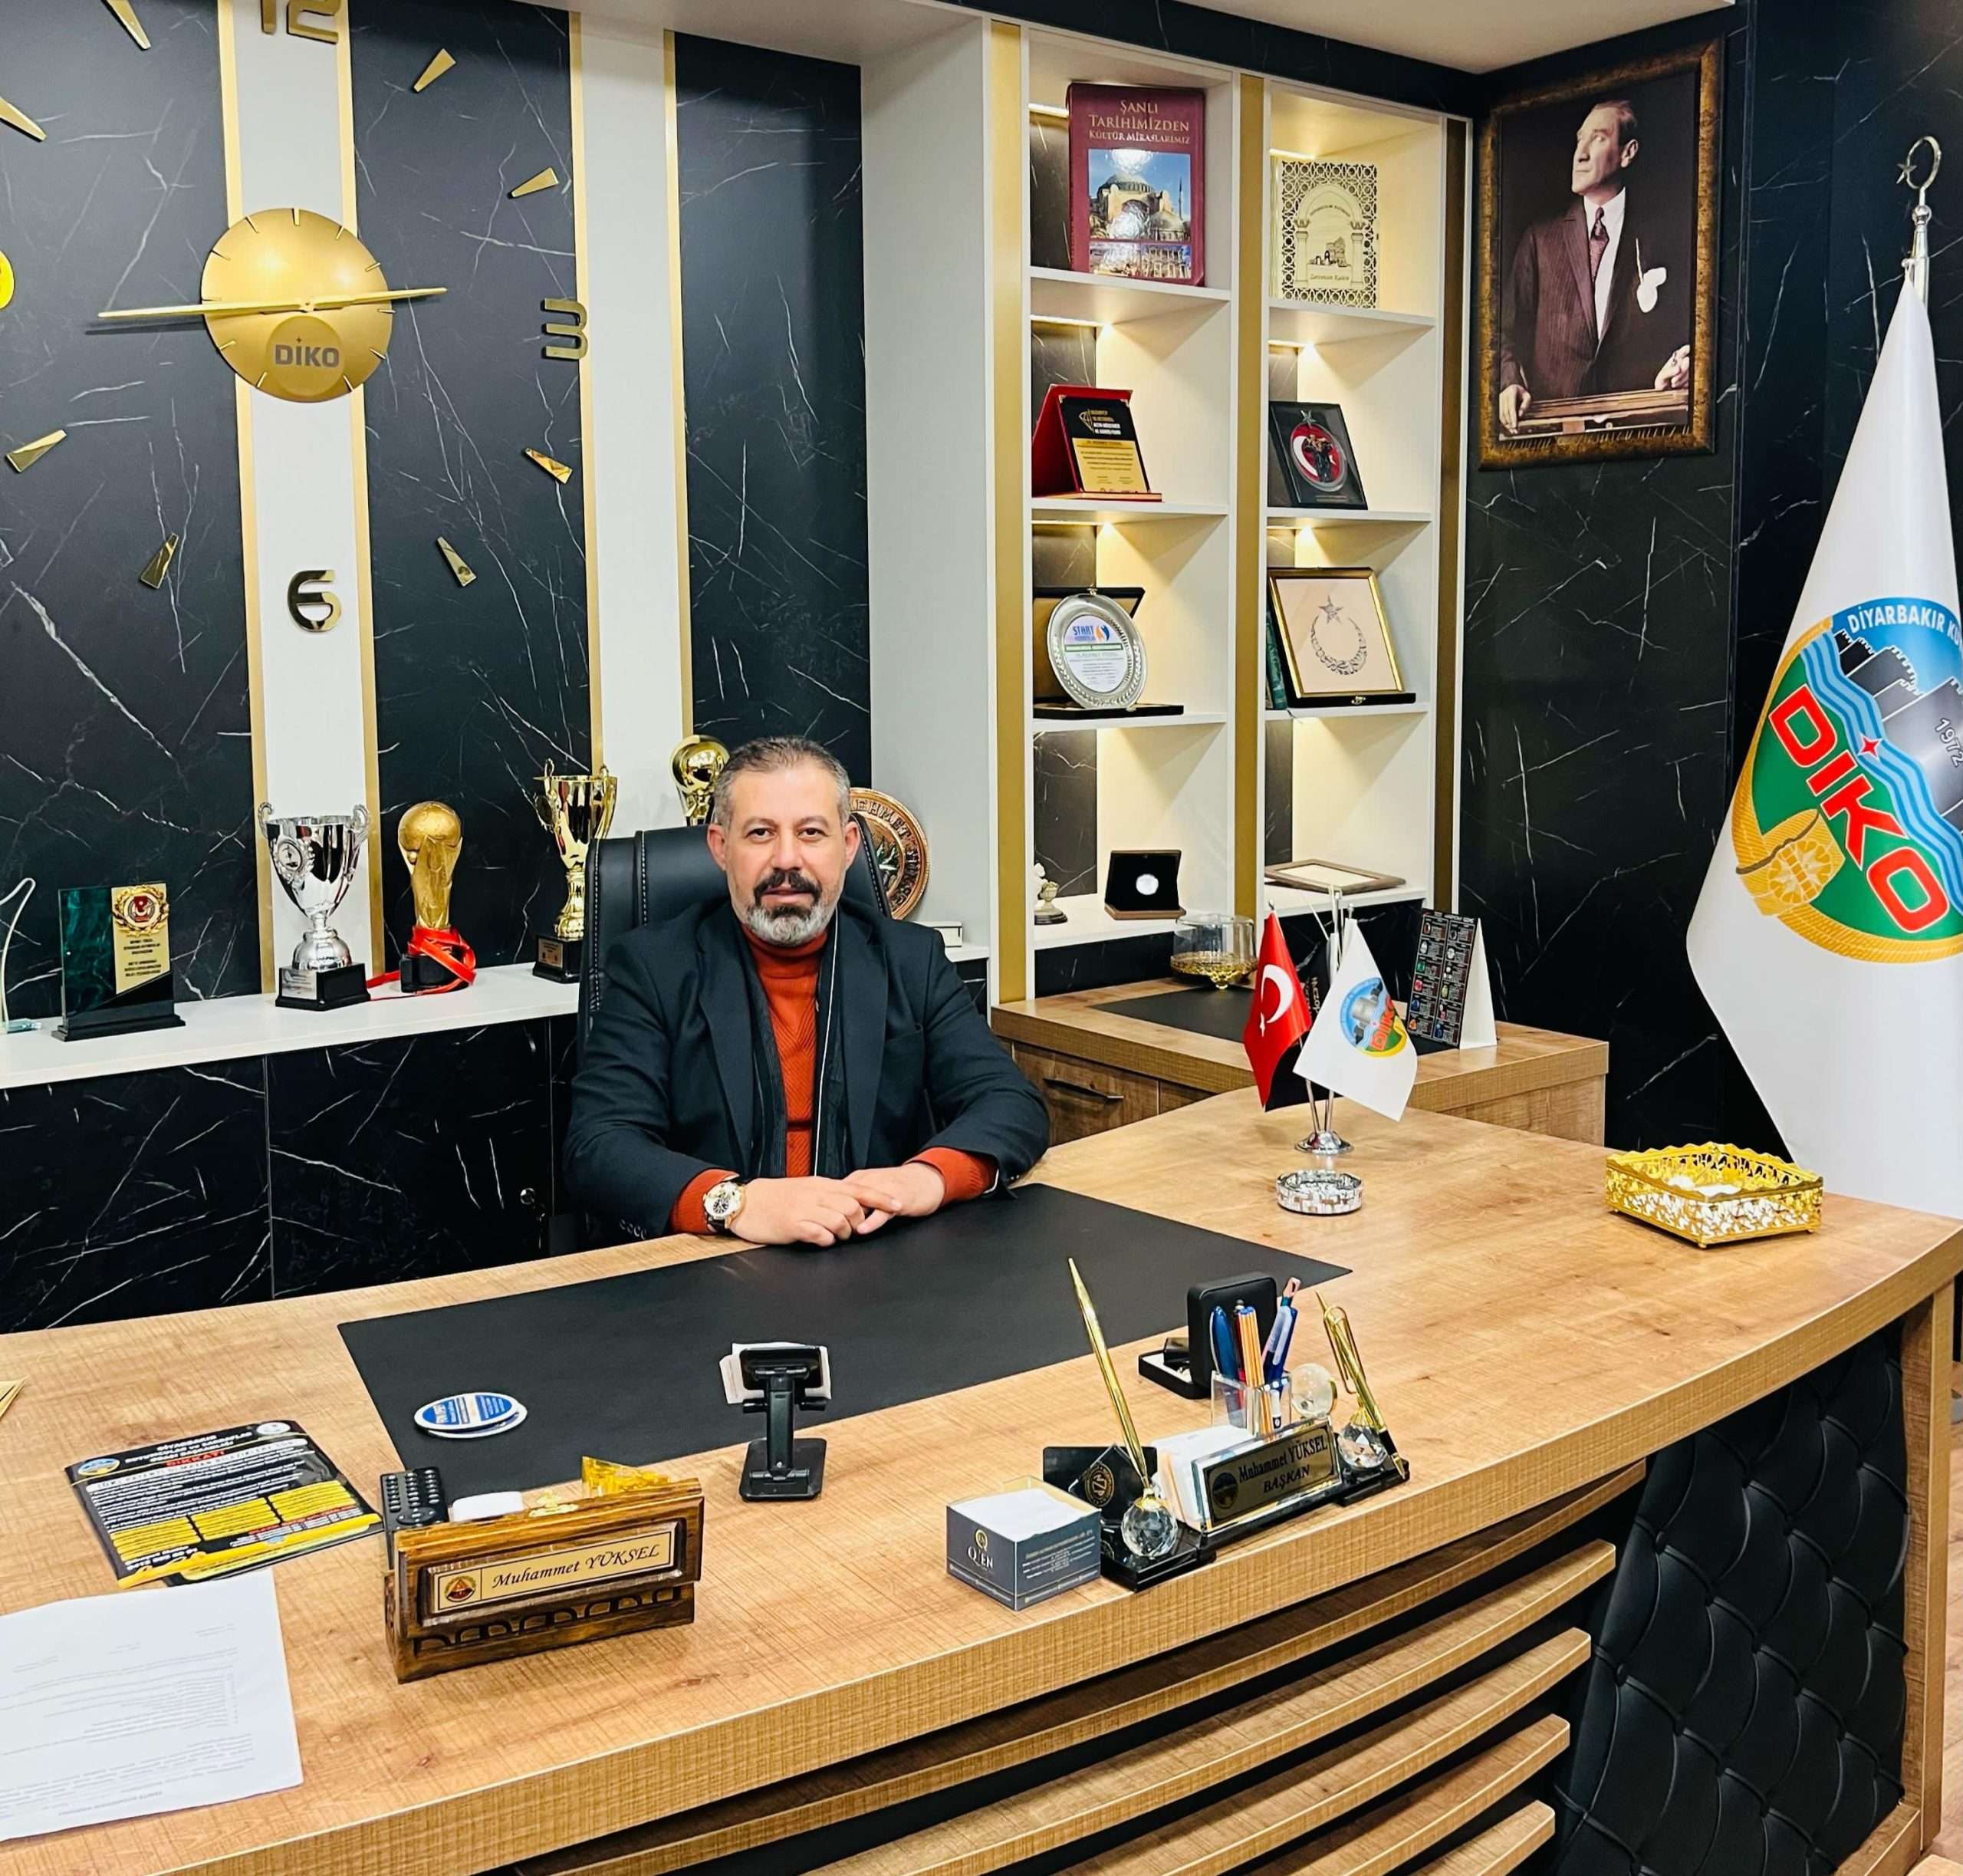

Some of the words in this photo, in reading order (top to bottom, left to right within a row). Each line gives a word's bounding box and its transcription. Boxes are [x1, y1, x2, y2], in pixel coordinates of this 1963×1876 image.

[261, 0, 339, 45] 12
[1088, 114, 1190, 133] TARİHİMİZDEN
[1120, 100, 1159, 115] ŞANLI
[1089, 129, 1125, 142] KÜLTÜR
[542, 297, 588, 361] 3
[287, 569, 342, 634] 6
[1846, 604, 1946, 636] DİYARBAKIR
[1935, 717, 1963, 769] 1972
[1238, 1452, 1287, 1484] Muhammet
[1287, 1434, 1328, 1463] YÜKSEL
[1263, 1464, 1311, 1493] BAŞKAN
[492, 1561, 580, 1588] Muhammet
[585, 1543, 660, 1570] YÜKSEL
